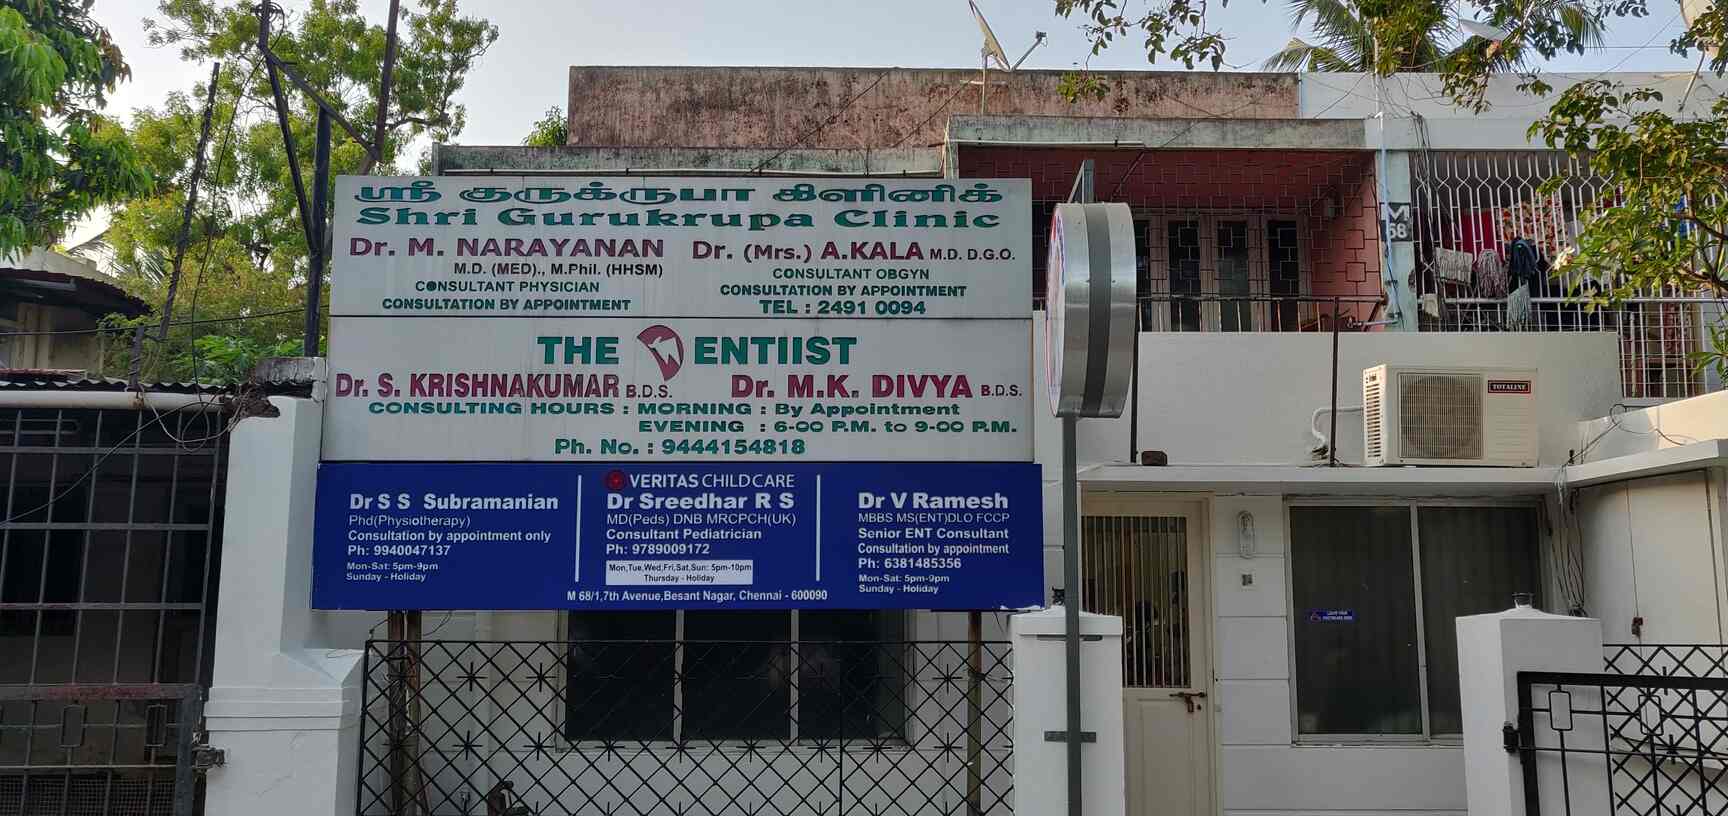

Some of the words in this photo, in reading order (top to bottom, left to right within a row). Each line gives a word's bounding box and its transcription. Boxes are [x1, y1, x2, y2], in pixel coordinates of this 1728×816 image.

[356, 207, 478, 226] Shri
[497, 207, 815, 231] Gurukrupa
[833, 209, 1001, 228] Clinic
[1380, 204, 1410, 221] M
[1387, 223, 1408, 239] 68
[350, 237, 395, 257] Dr.
[408, 237, 444, 257] M.
[456, 237, 664, 257] NARAYANAN
[692, 241, 733, 260] Dr.
[743, 243, 812, 263] (Mrs.)
[820, 241, 924, 260] A.KALA
[929, 248, 963, 260] M.D.
[967, 248, 1016, 261] D.G.O.
[453, 262, 487, 274] M.D.
[491, 262, 545, 277] (MED).,
[550, 262, 601, 275] M.Phil.
[606, 262, 663, 277] (HHSM)
[772, 268, 872, 280] CONSULTANT
[876, 268, 930, 280] OBGYN
[415, 281, 514, 293] CONSULTANT
[519, 281, 600, 293] PHYSICIAN
[720, 284, 833, 296] CONSULTATION
[837, 285, 857, 296] BY
[861, 285, 967, 297] APPOINTMENT
[382, 297, 495, 310] CONSULTATION
[500, 298, 522, 310] BY
[523, 298, 631, 311] APPOINTMENT
[759, 300, 798, 314] TEL
[817, 300, 866, 315] 2491
[874, 300, 926, 315] 0094
[536, 336, 620, 364] THE
[335, 373, 368, 397] Dr.
[377, 373, 400, 398] S.
[410, 373, 620, 398] KRISHNAKUMAR
[625, 384, 673, 398] B.D.S.
[730, 374, 775, 398] Dr.
[787, 374, 859, 398] M.K.
[871, 374, 973, 398] DIVYA
[980, 385, 1022, 397] B.D.S.
[368, 402, 522, 414] CONSULTING
[530, 402, 615, 415] HOURS
[637, 402, 752, 415] MORNING
[775, 403, 803, 417] By
[810, 403, 960, 418] Appointment
[639, 420, 745, 433] EVENING
[774, 421, 824, 433] 6-00
[832, 421, 876, 433] P.M.
[884, 421, 908, 433] to
[915, 421, 965, 433] 9-00
[972, 421, 1017, 433] P.M.
[554, 438, 592, 455] Ph.
[600, 438, 639, 455] No.
[660, 439, 806, 455] 9444154818
[629, 474, 699, 488] VERITAS
[350, 493, 373, 510] Dr
[377, 493, 391, 510] S
[397, 493, 410, 510] S
[423, 493, 559, 510] Subramanian
[607, 493, 634, 509] Dr
[639, 492, 748, 510] Sreedhar
[755, 493, 772, 509] R
[779, 492, 795, 510] S
[858, 493, 885, 509] Dr
[891, 493, 908, 509] V
[912, 492, 1009, 509] Ramesh
[349, 515, 471, 528] Phd(Physiotherapy)
[607, 514, 670, 527] MD(Peds)
[673, 514, 703, 525] DNB
[706, 513, 796, 527] MRCPCH(UK)
[858, 513, 893, 523] MBBS
[896, 512, 973, 525] MS(ENT)DLO
[976, 513, 1010, 523] FCCP
[348, 530, 425, 541] Consultation
[428, 530, 443, 543] by
[446, 531, 522, 543] appointment
[525, 531, 551, 544] only
[606, 529, 679, 540] Consultant
[683, 528, 762, 540] Pediatrician
[858, 528, 901, 539] Senior
[905, 528, 933, 539] ENT
[936, 528, 1009, 539] Consultant
[347, 545, 370, 556] Ph:
[373, 545, 451, 556] 9940047137
[606, 544, 628, 555] Ph:
[632, 544, 710, 555] 9789009172
[857, 543, 925, 554] Consultation
[927, 543, 941, 556] by
[943, 543, 1009, 556] appointment
[346, 562, 390, 570] Mon-Sat:
[392, 562, 439, 572] 5pm-9pm
[711, 563, 752, 573] 5pm-10pm
[858, 558, 880, 569] Ph:
[884, 558, 962, 569] 6381485356
[346, 572, 382, 583] Sunday
[390, 572, 426, 583] Holiday
[644, 574, 679, 583] Thursday
[686, 574, 715, 584] Holiday
[858, 575, 902, 583] Mon-Sat:
[904, 574, 950, 584] 5pm-9pm
[567, 591, 576, 601] M
[739, 591, 782, 601] Chennai
[791, 590, 828, 601] 600090
[858, 584, 895, 594] Sunday
[903, 584, 939, 594] Holiday
